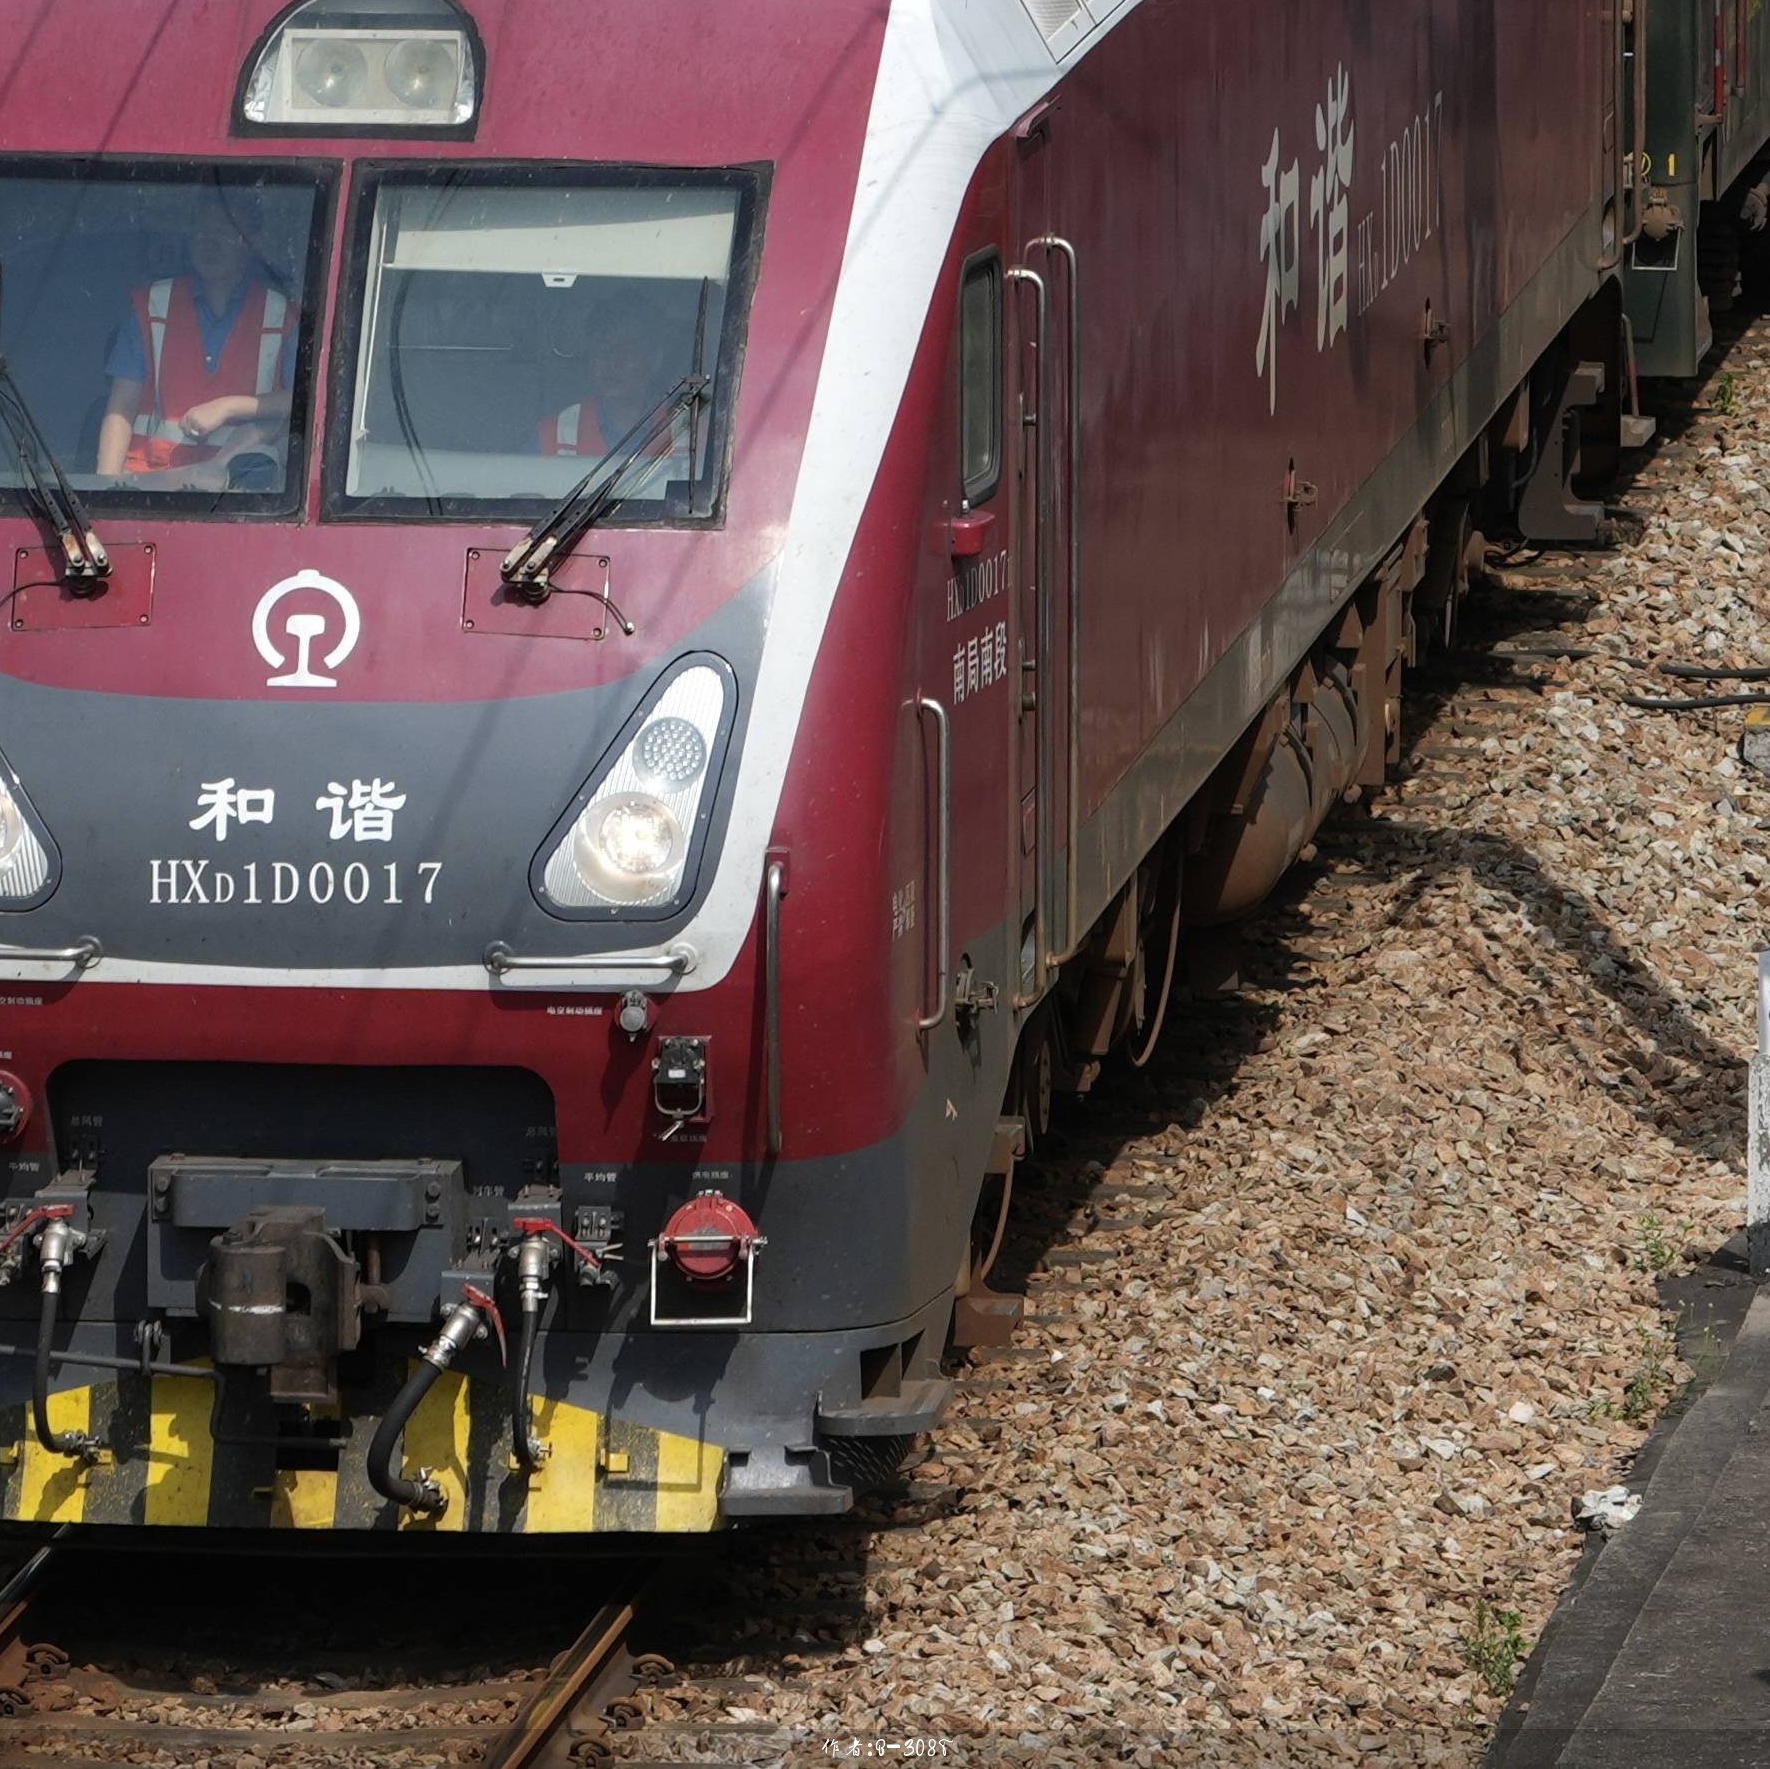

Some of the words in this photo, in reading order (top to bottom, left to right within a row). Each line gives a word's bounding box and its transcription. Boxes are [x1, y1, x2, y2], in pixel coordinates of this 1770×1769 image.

[1256, 61, 1354, 417] 和谐
[953, 621, 1007, 705] 南局南段
[189, 777, 407, 842] 和谐
[149, 859, 443, 904] HXD1D0017
